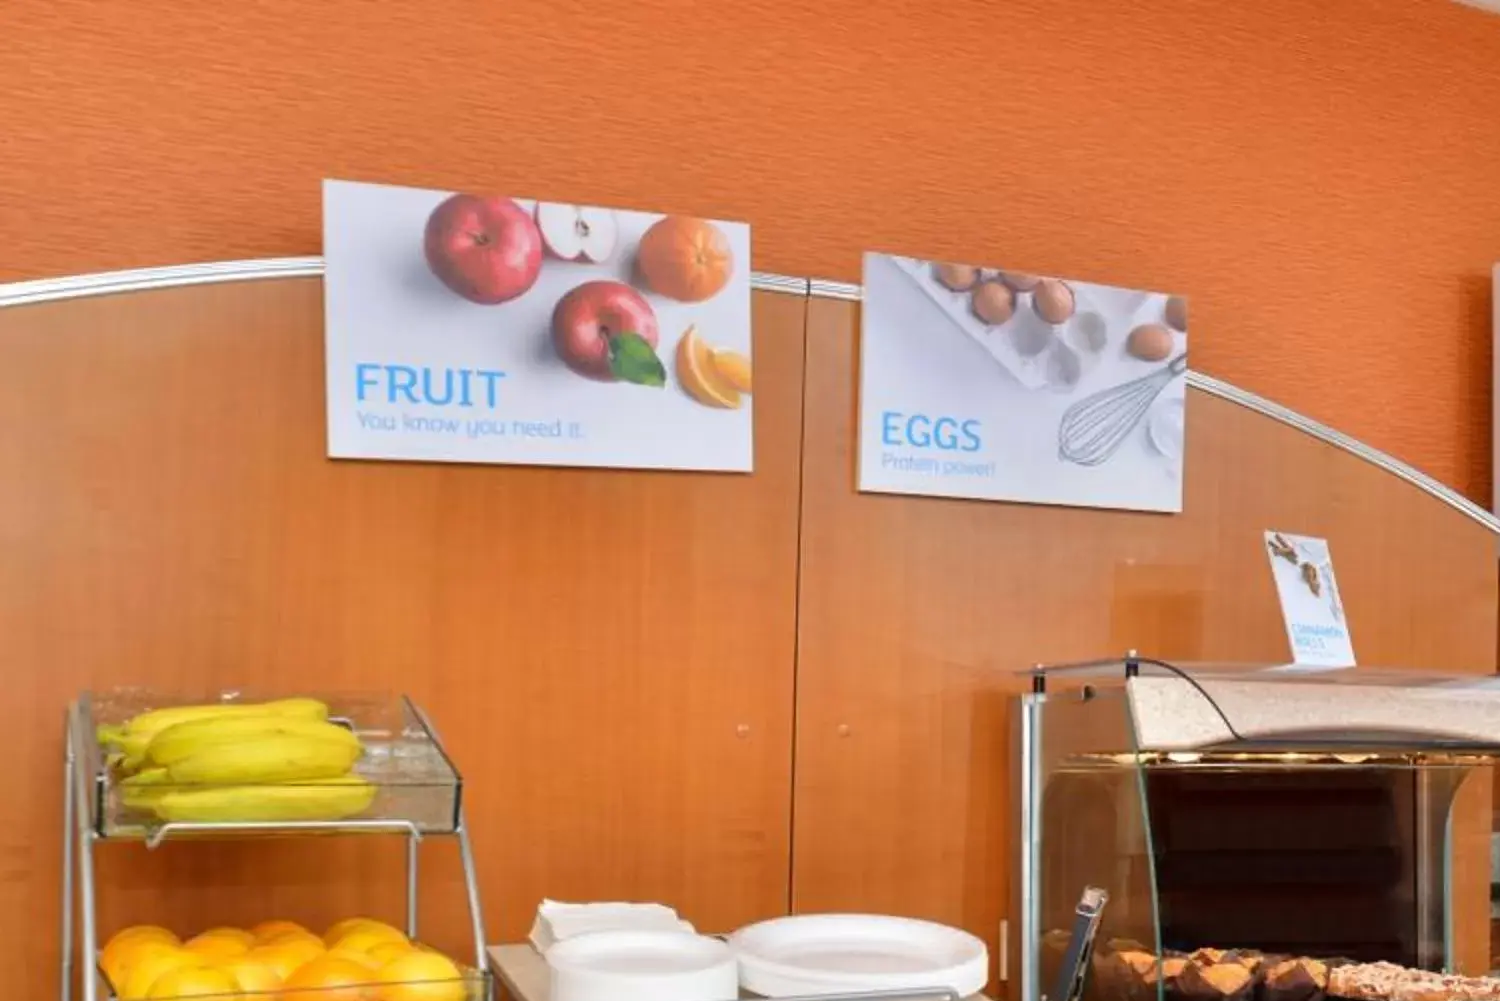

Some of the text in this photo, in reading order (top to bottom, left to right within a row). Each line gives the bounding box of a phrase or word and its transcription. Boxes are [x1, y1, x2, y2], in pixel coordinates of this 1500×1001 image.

[356, 363, 506, 409] FRUIT
[357, 411, 396, 432] You
[402, 413, 460, 434] know
[466, 419, 505, 439] you
[513, 418, 561, 438] need
[881, 411, 982, 453] EGGS
[882, 452, 938, 475] Protein
